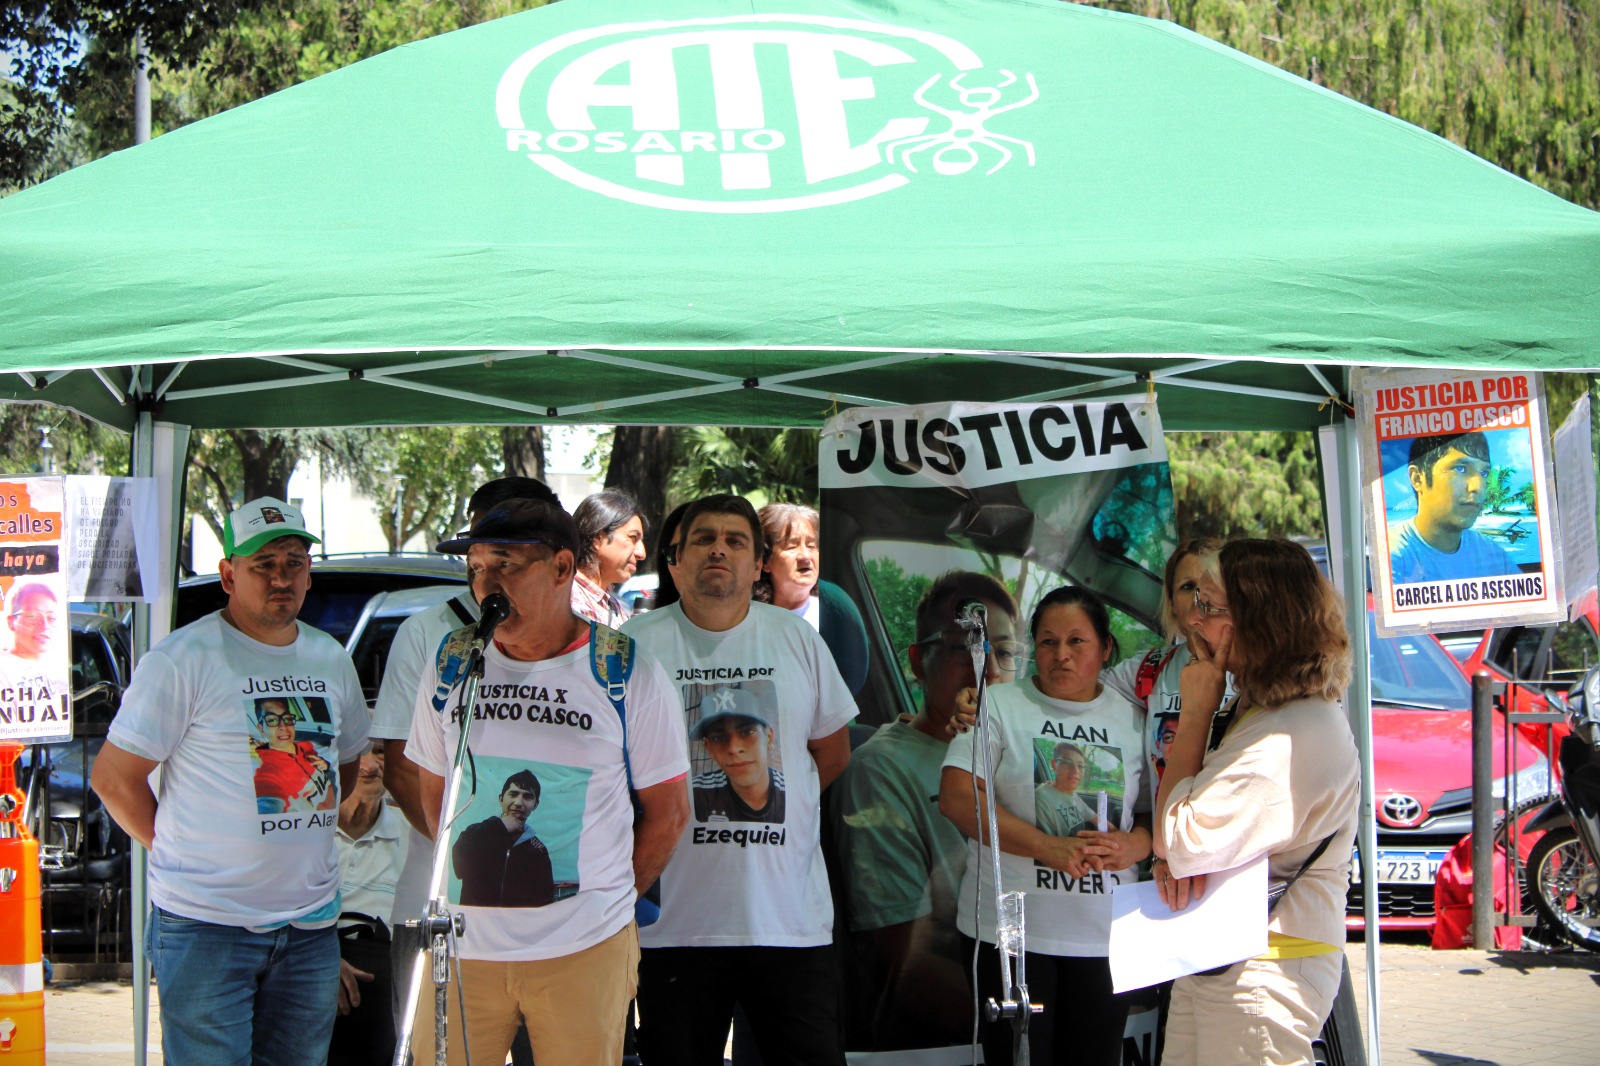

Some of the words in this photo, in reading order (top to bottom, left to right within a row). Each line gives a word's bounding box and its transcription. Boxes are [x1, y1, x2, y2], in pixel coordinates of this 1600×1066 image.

[547, 30, 930, 190] ATE
[506, 129, 786, 154] ROSARIO
[1376, 380, 1478, 413] JUSTICIA
[1482, 375, 1529, 402] POR
[1379, 410, 1456, 438] FRANCO
[1459, 404, 1526, 430] CASCO
[836, 402, 1149, 476] JUSTICIA
[4, 551, 46, 571] haya
[1396, 585, 1443, 607] CARCEL
[1445, 584, 1454, 603] A
[1456, 582, 1479, 602] LOS
[1481, 576, 1543, 600] ASESINOS
[242, 676, 327, 695] Justicia
[676, 667, 744, 681] JUSTICIA
[748, 667, 775, 679] por
[1, 686, 52, 703] CHA
[477, 684, 550, 702] USTICIA
[554, 689, 569, 704] X
[526, 704, 593, 731] CASCO
[1040, 720, 1109, 745] ALAN
[261, 818, 302, 835] por
[693, 825, 786, 848] Ezequiel
[1387, 862, 1421, 881] 723
